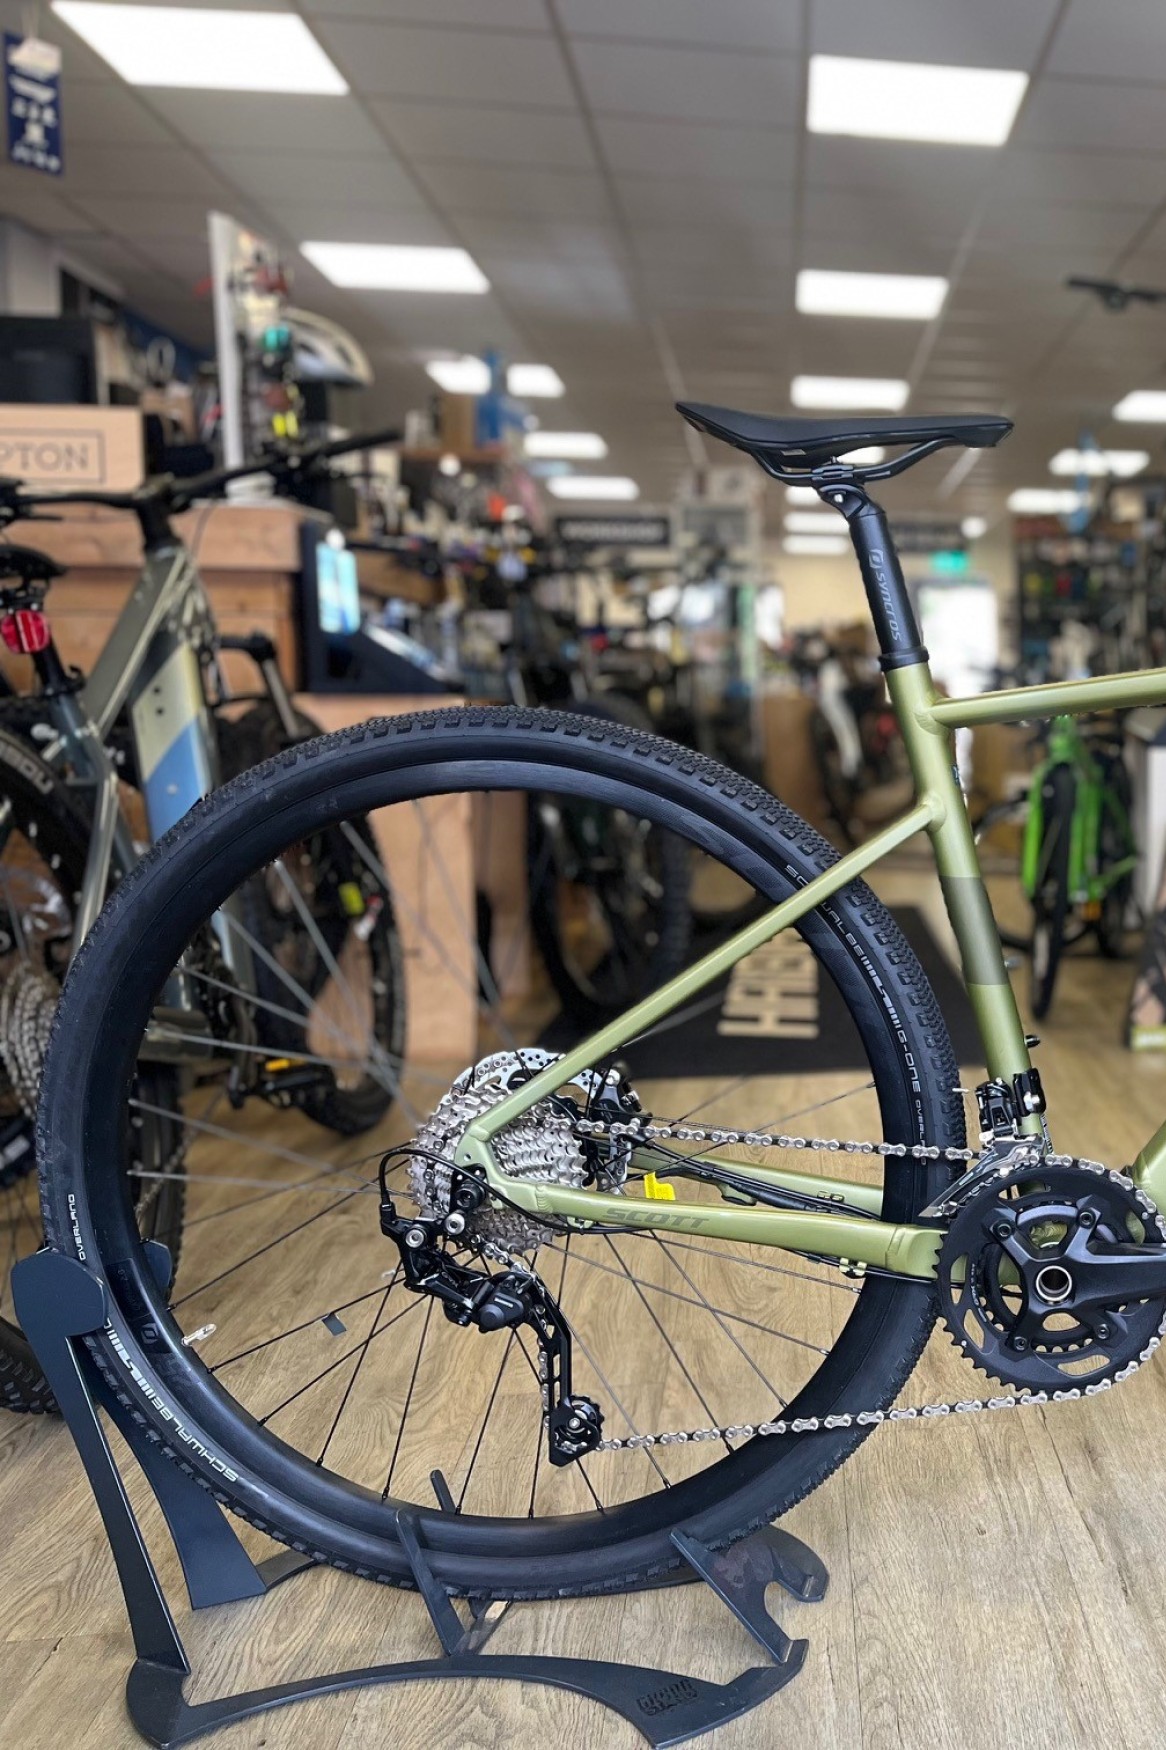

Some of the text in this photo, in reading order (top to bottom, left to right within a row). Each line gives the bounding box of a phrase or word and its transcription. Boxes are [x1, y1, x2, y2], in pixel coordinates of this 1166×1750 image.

[784, 864, 864, 957] SCWALBE
[68, 1194, 86, 1261] OVERLAND
[603, 1207, 709, 1229] SCOTT
[151, 1397, 239, 1482] SCHWALBE
